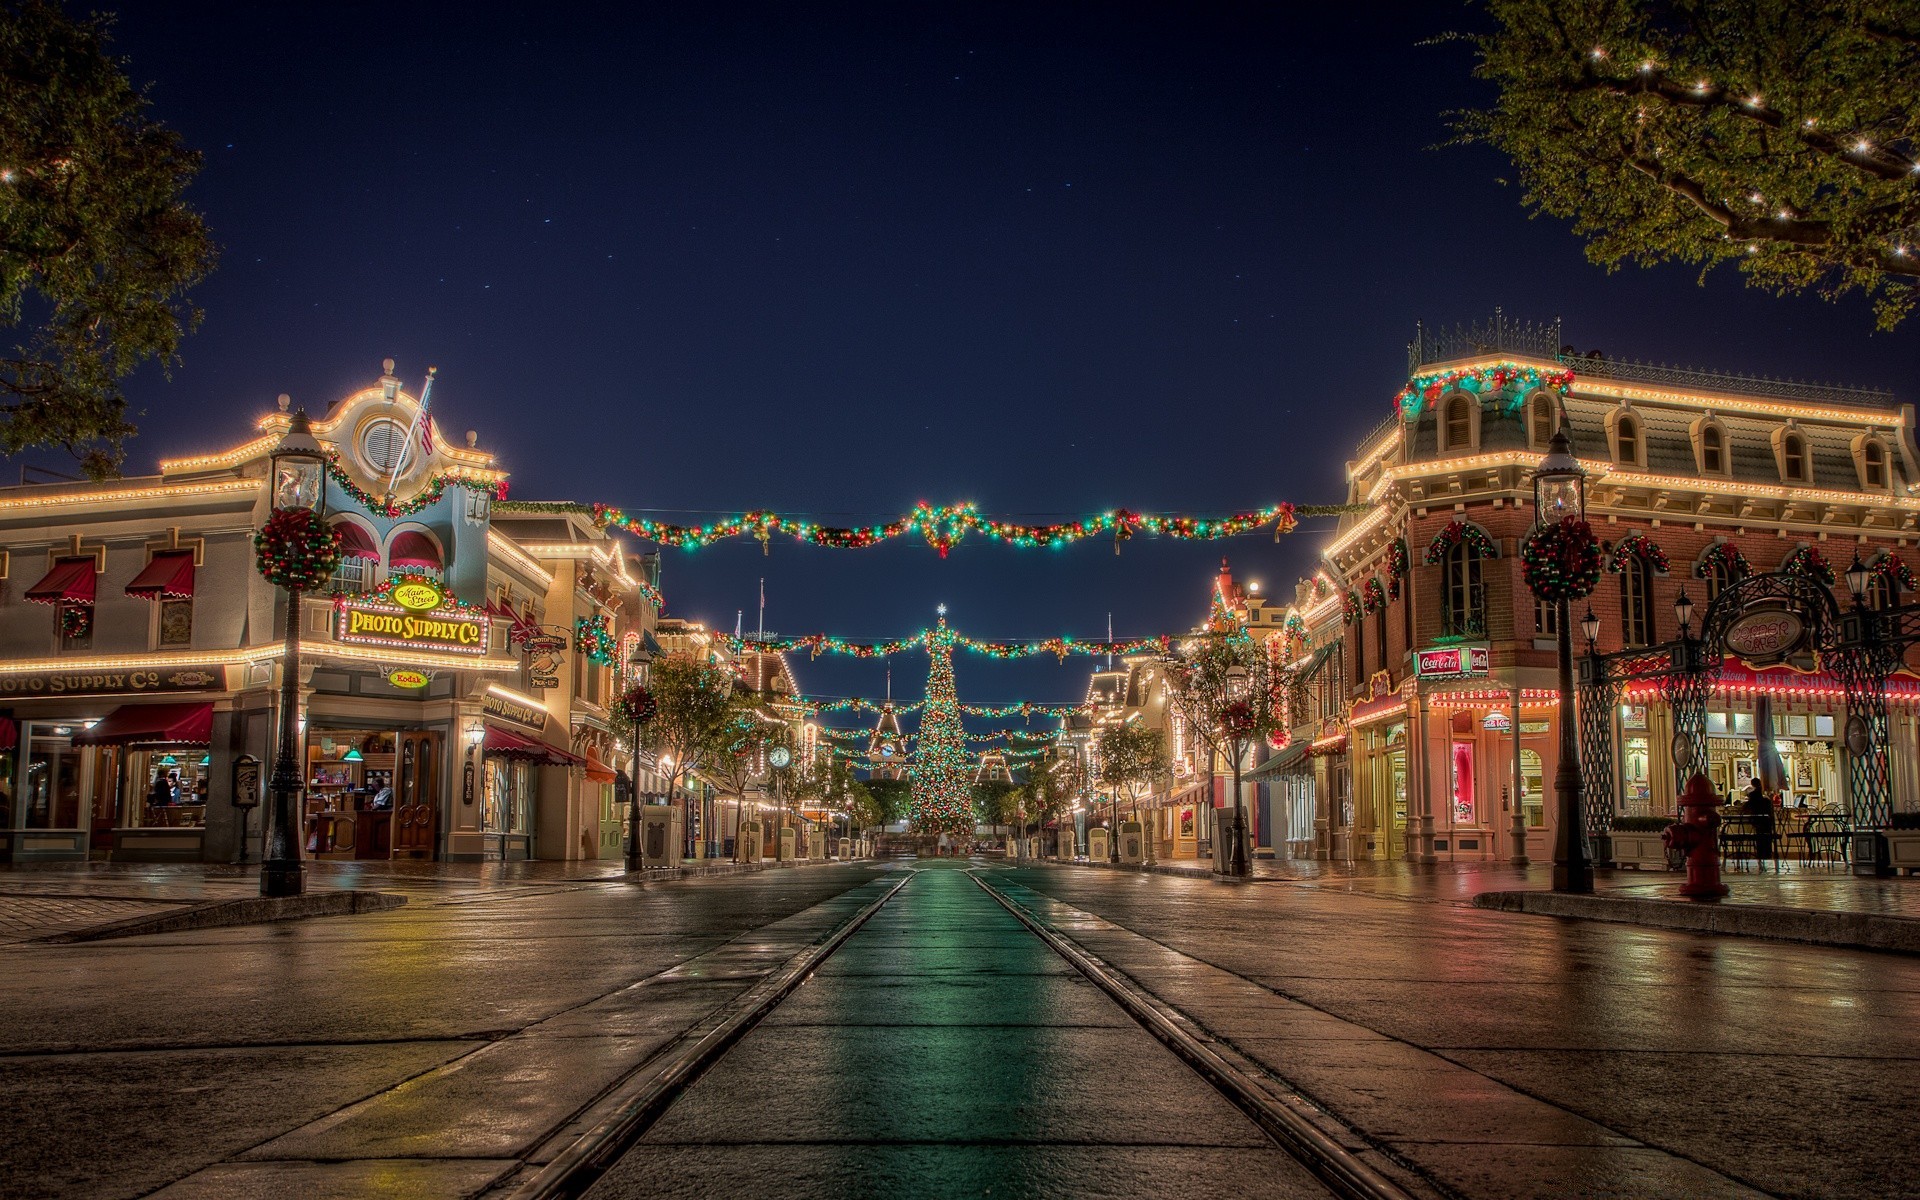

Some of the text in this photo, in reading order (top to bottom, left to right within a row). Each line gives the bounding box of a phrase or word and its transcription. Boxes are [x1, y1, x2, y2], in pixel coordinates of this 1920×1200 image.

[398, 587, 431, 598] Main
[408, 595, 435, 607] Street
[350, 611, 403, 633] PHOTO
[403, 617, 460, 640] SUPPLY
[0, 677, 44, 691] OTO
[50, 674, 126, 693] SUPPLY
[397, 674, 421, 684] Kodak
